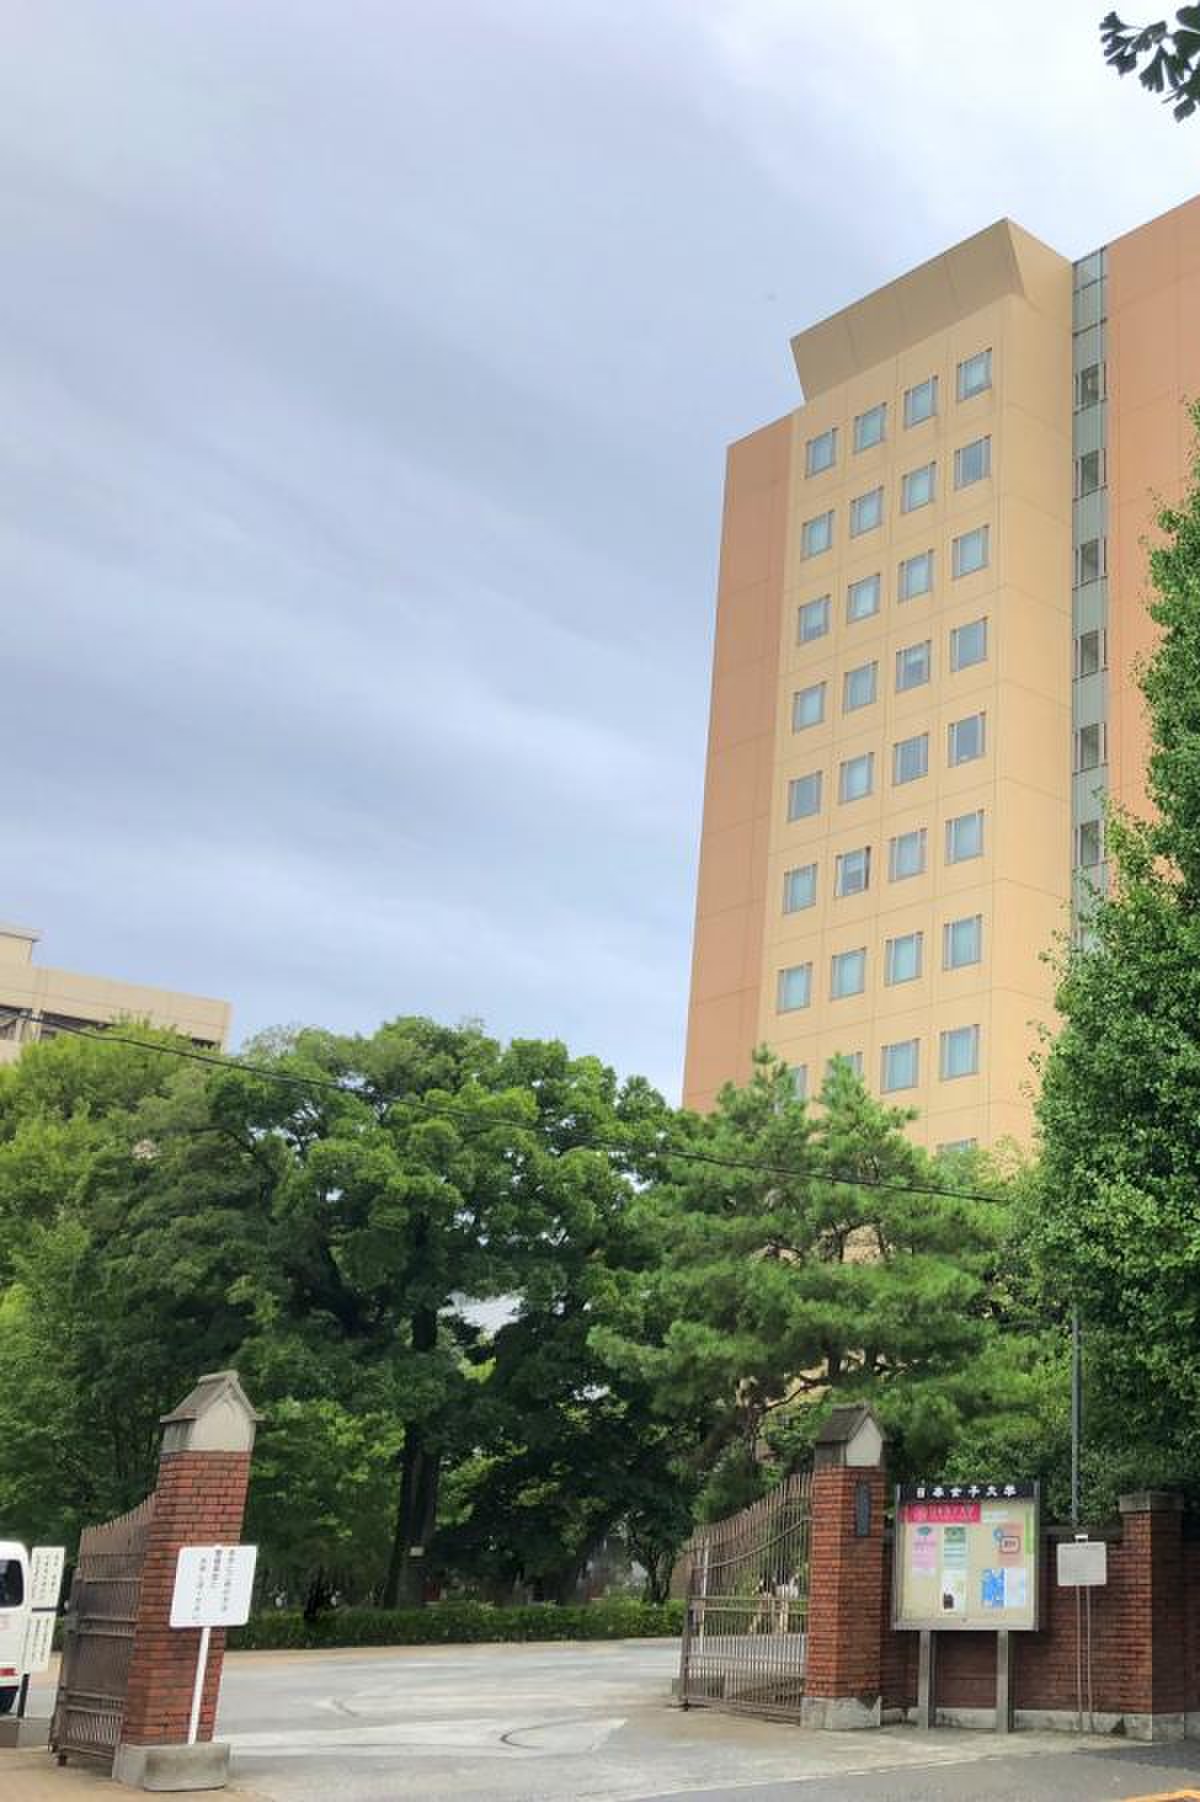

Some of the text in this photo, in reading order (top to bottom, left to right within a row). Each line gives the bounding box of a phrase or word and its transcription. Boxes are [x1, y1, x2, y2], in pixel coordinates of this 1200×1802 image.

[916, 1484, 1017, 1498] 日本女子大学
